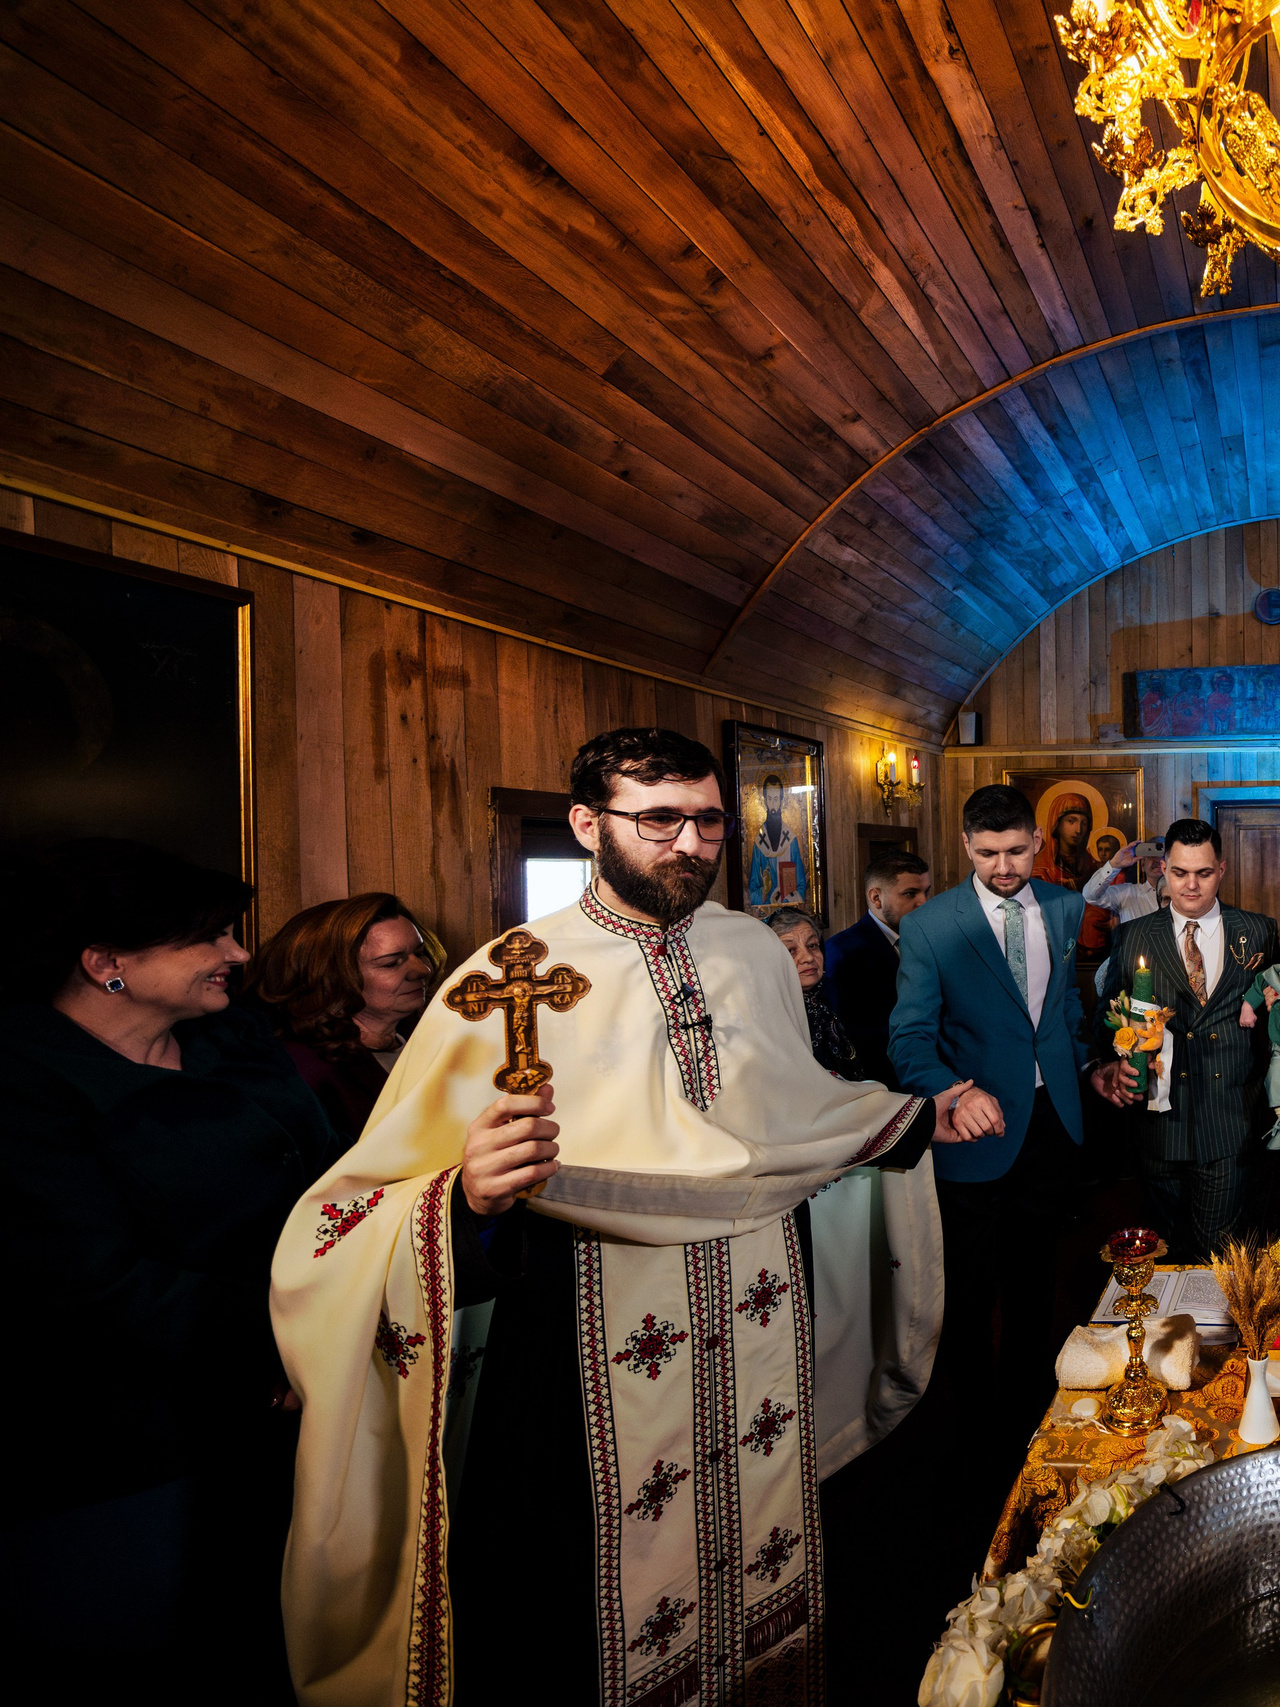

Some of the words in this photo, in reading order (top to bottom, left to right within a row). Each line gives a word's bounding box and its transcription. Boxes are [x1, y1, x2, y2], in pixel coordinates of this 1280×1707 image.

[554, 975, 571, 984] HS
[554, 994, 571, 1004] KA
[468, 1002, 485, 1012] NI
